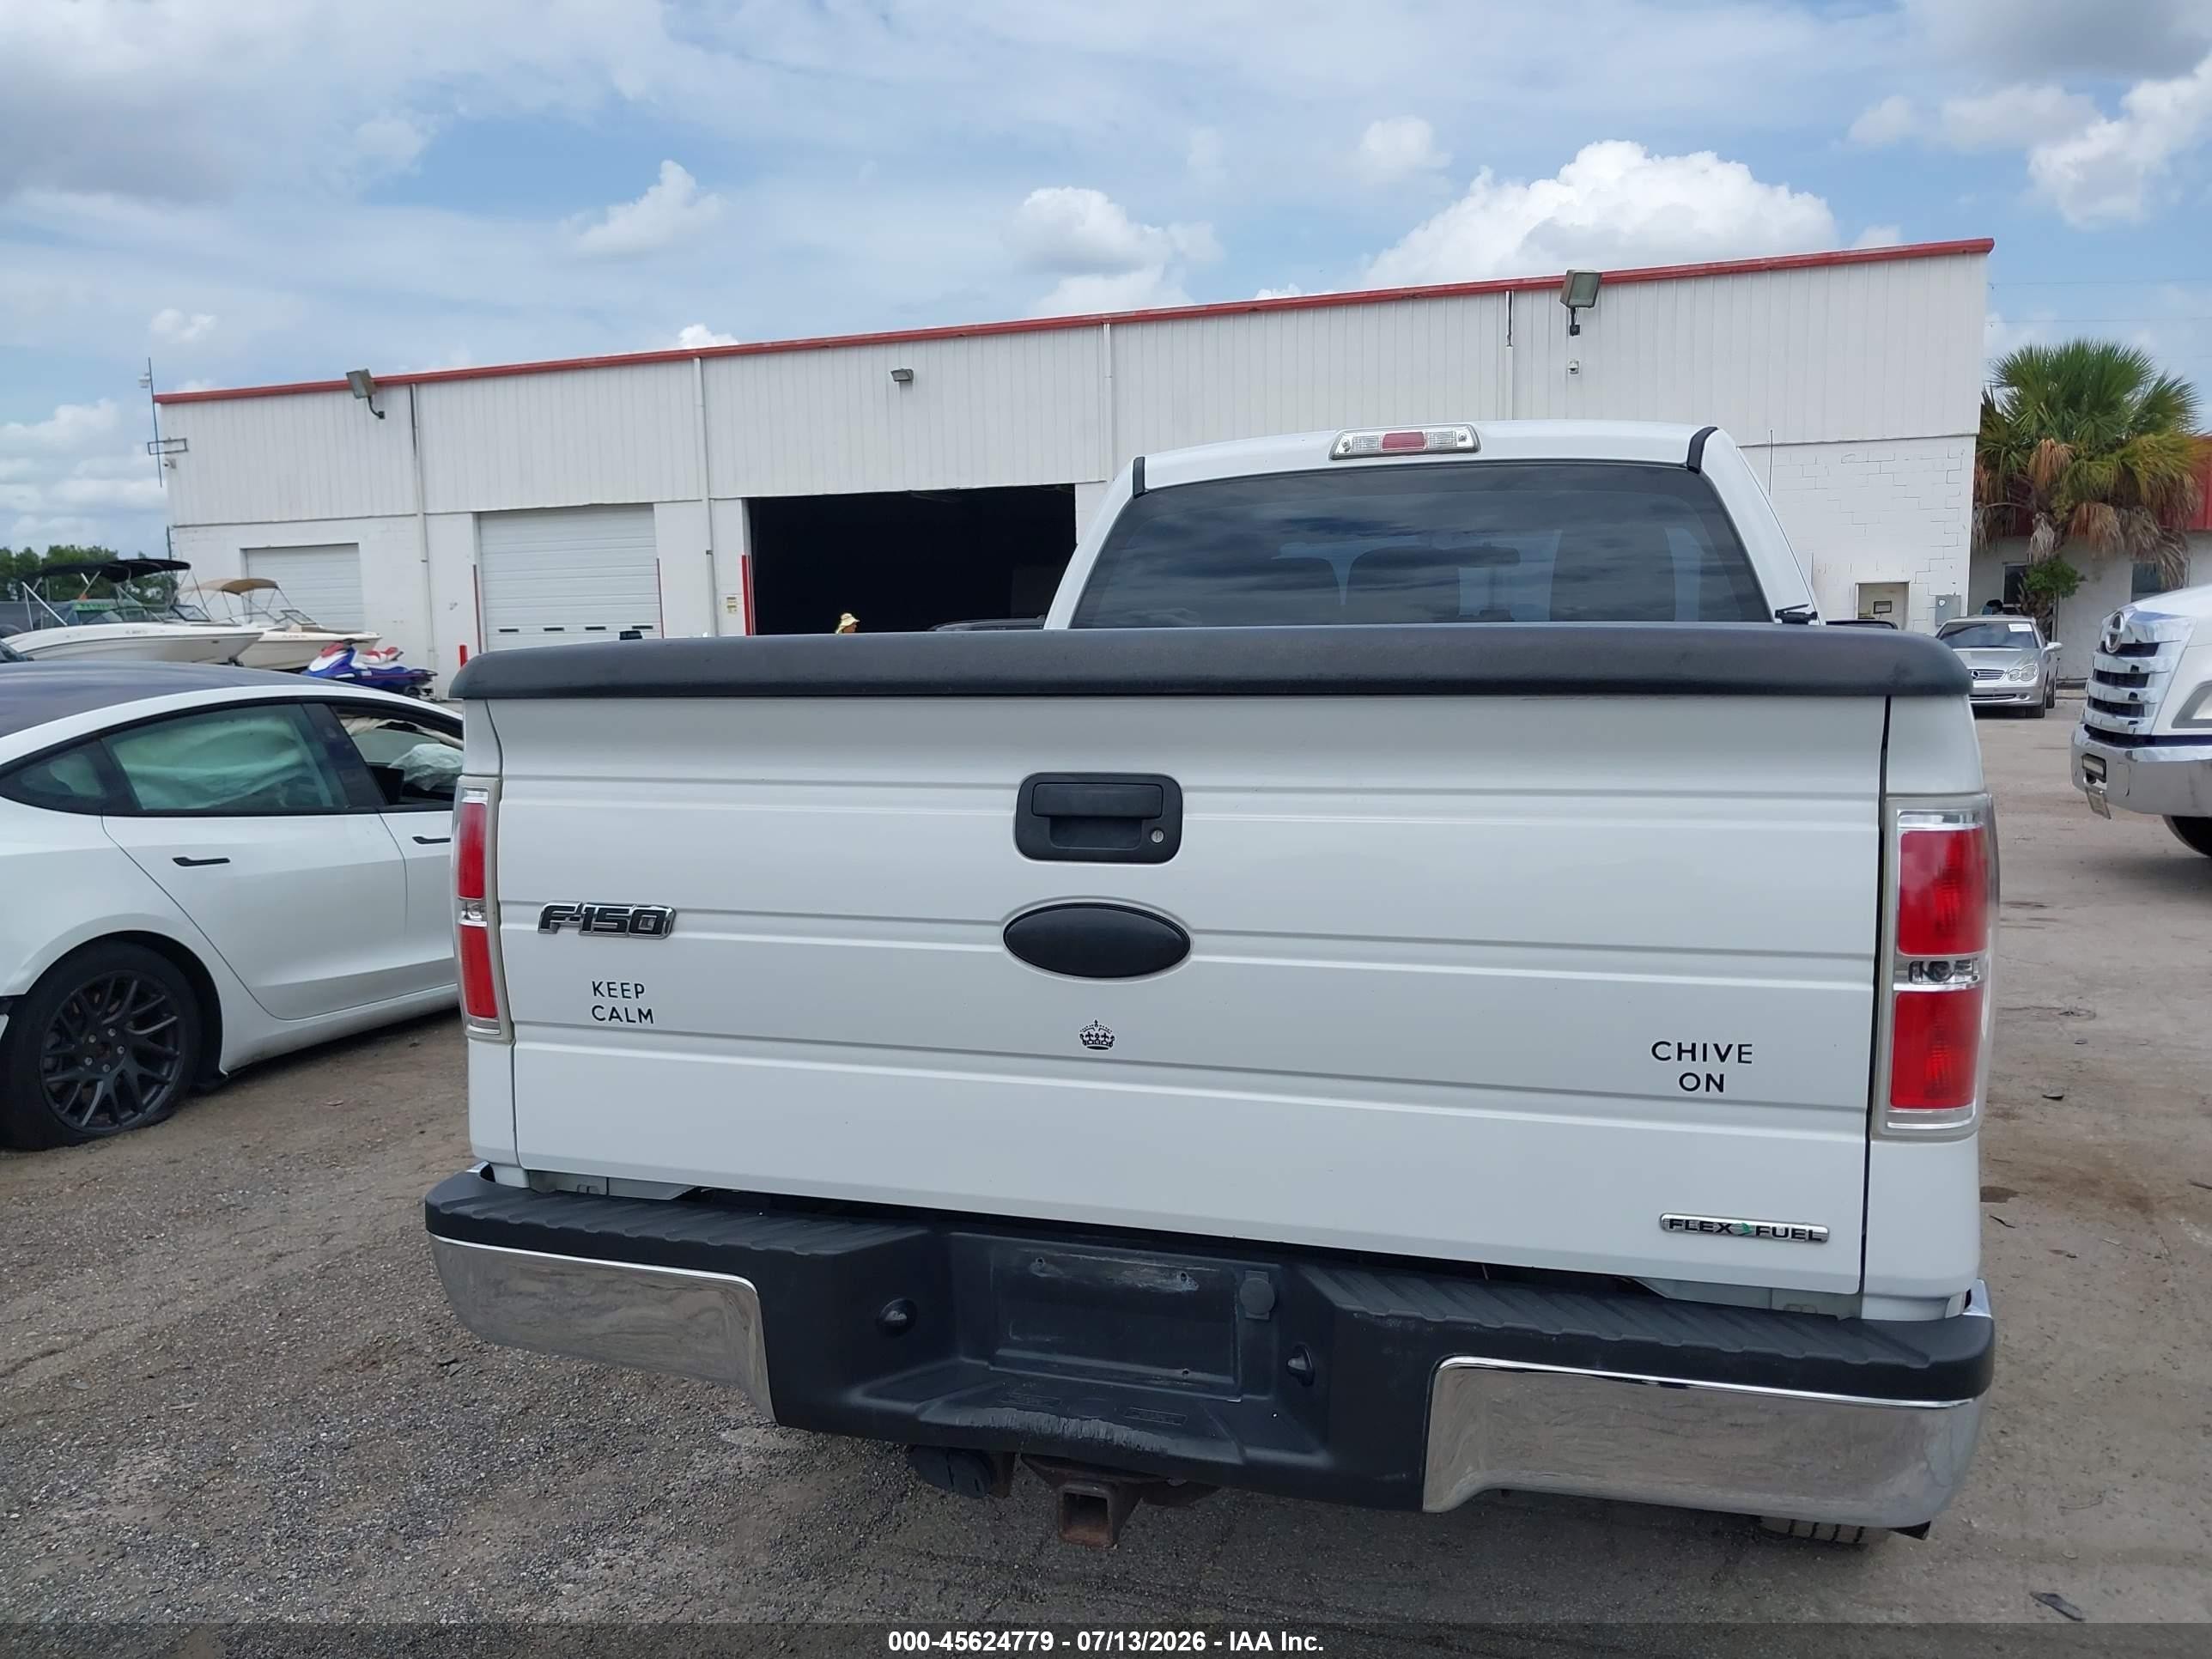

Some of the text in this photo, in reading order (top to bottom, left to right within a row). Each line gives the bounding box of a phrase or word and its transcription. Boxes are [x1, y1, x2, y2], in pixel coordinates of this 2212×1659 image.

[591, 981, 646, 1000] KEEP
[591, 1005, 654, 1024] CALM
[1650, 1041, 1753, 1064] CHIVE
[1678, 1072, 1725, 1093] ON
[1668, 1218, 1822, 1242] FLEX FUEL
